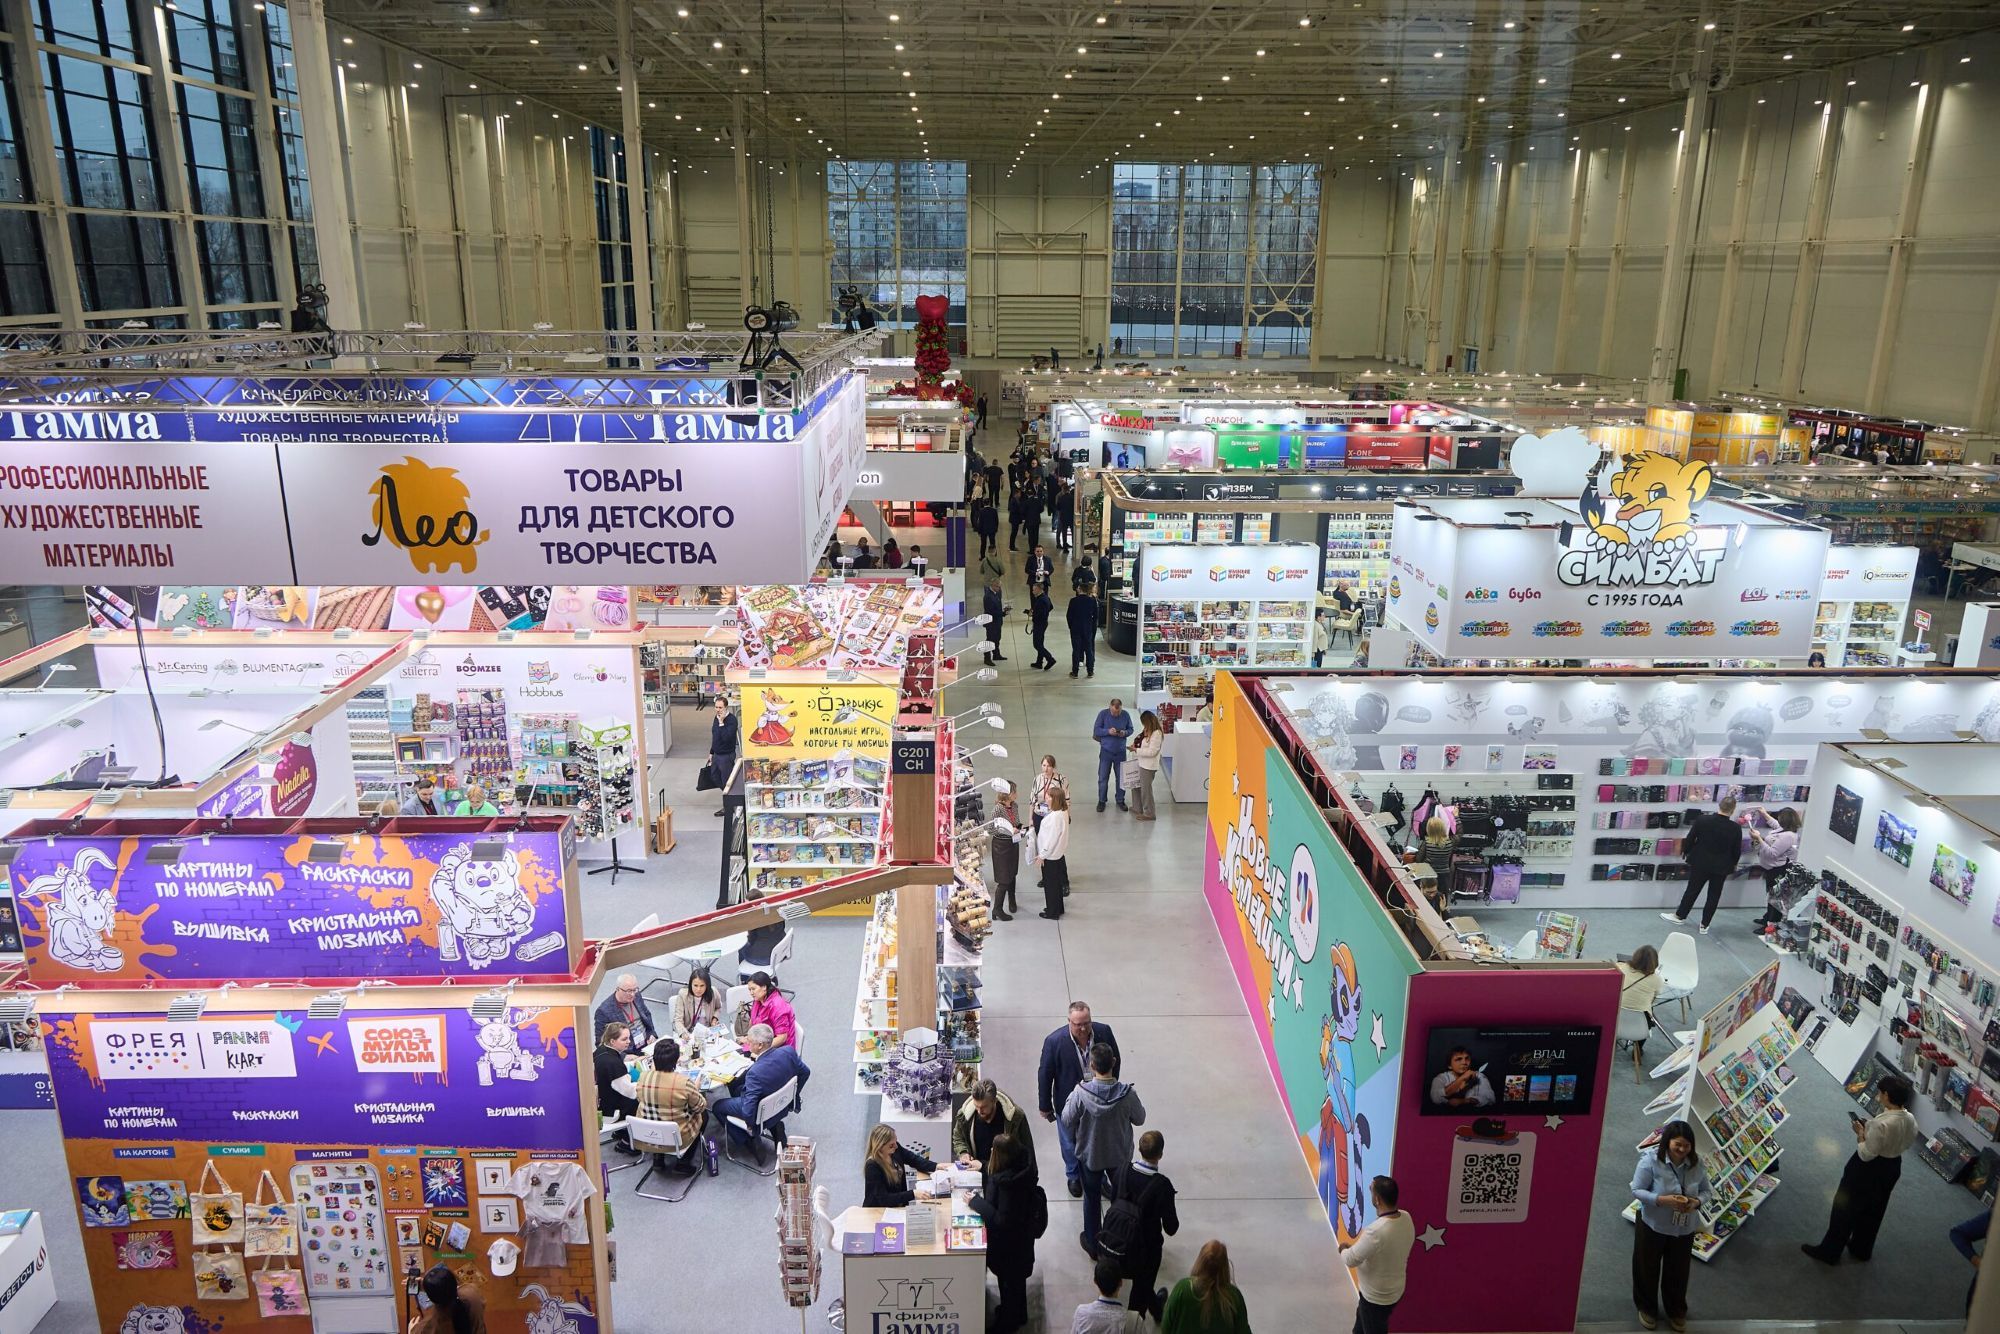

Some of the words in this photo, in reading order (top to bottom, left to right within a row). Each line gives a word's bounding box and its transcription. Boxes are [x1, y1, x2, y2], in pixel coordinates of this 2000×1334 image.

[241, 388, 362, 401] КАНЦЕЛЯРСКИЕ
[370, 389, 430, 401] ТОВАРЫ
[217, 412, 363, 424] ХУДОЖЕСТВЕННЫЕ
[648, 389, 795, 440] Гамма
[1204, 416, 1243, 424] САМСОН
[1100, 413, 1154, 430] САМСОН
[241, 433, 302, 443] ТОВАРЫ
[343, 433, 442, 443] ТВОРЧЕСТВА
[564, 469, 683, 492] ТОВАРЫ
[361, 475, 478, 548] Лео
[2, 504, 203, 532] ХУДОЖЕСТВЕННЫЕ
[518, 505, 580, 533] ДЛЯ
[588, 505, 734, 533] ДЕТСКОГО
[43, 544, 175, 567] МАТЕРИАЛЫ
[540, 542, 717, 565] ТВОРЧЕСТВА
[1557, 547, 1727, 587] СИМБАТ
[1509, 587, 1541, 602] буба
[1744, 587, 1768, 598] LOL
[1587, 593, 1599, 606] С
[1604, 593, 1637, 606] 1995
[1640, 593, 1684, 607] ГОДА
[1464, 624, 1508, 633] МУЛЬТИАРТ
[1536, 624, 1581, 633] МУЛЬТИАРТ
[1604, 624, 1649, 633] МУЛЬТИАРТ
[1669, 624, 1714, 633] МУЛЬТИАРТ
[1732, 624, 1778, 633] МУЛЬТИАРТ
[157, 660, 208, 674] Mr.Carving
[242, 663, 304, 673] BLUMENTAG
[402, 663, 440, 677] stilerra
[456, 663, 502, 674] BOOMZEE
[809, 727, 857, 735] НАСТОЛЬНЫЕ
[861, 726, 883, 736] ИГРЫ,
[804, 739, 838, 748] КОТОРЫЕ
[842, 739, 853, 748] ТЫ
[857, 739, 889, 748] ЛЮБИШЬ
[898, 747, 929, 758] G201
[905, 760, 924, 770] CH
[163, 862, 253, 880] КАРТИНЫ
[301, 864, 411, 887] РАСКРАСКИ
[156, 882, 180, 898] ПО
[184, 881, 274, 898] НОМЕРАМ
[1223, 821, 1296, 1002] КОЛЛЕКЦИИ
[288, 910, 418, 933] КРИСТАЛЬНАЯ
[174, 920, 270, 943] ВЫШИВКА
[319, 928, 404, 950] МОЗАИКА
[213, 1030, 269, 1046] PANNA
[364, 1028, 426, 1040] СОЮЗ
[107, 1032, 186, 1049] ФРЕЯ
[363, 1039, 432, 1052] МУЛЬТ
[361, 1050, 435, 1064] ФИЛЬМ
[1533, 1049, 1565, 1059] ВЛАД
[109, 1107, 164, 1118] КАРТИНЫ
[355, 1103, 435, 1114] КРИСТАЛЬНАЯ
[486, 1107, 545, 1117] ВЫШИВКА
[233, 1110, 299, 1121] РАСКРАСКИ
[372, 1113, 425, 1124] МОЗАИКА
[104, 1118, 118, 1128] ПО
[121, 1117, 177, 1128] НОМЕРАМ
[133, 1148, 169, 1156] КАРТОНЕ
[312, 1150, 352, 1158] МАГНИТЫ
[1, 1265, 33, 1306] СВЕТОЧ
[895, 1311, 960, 1322] фирма
